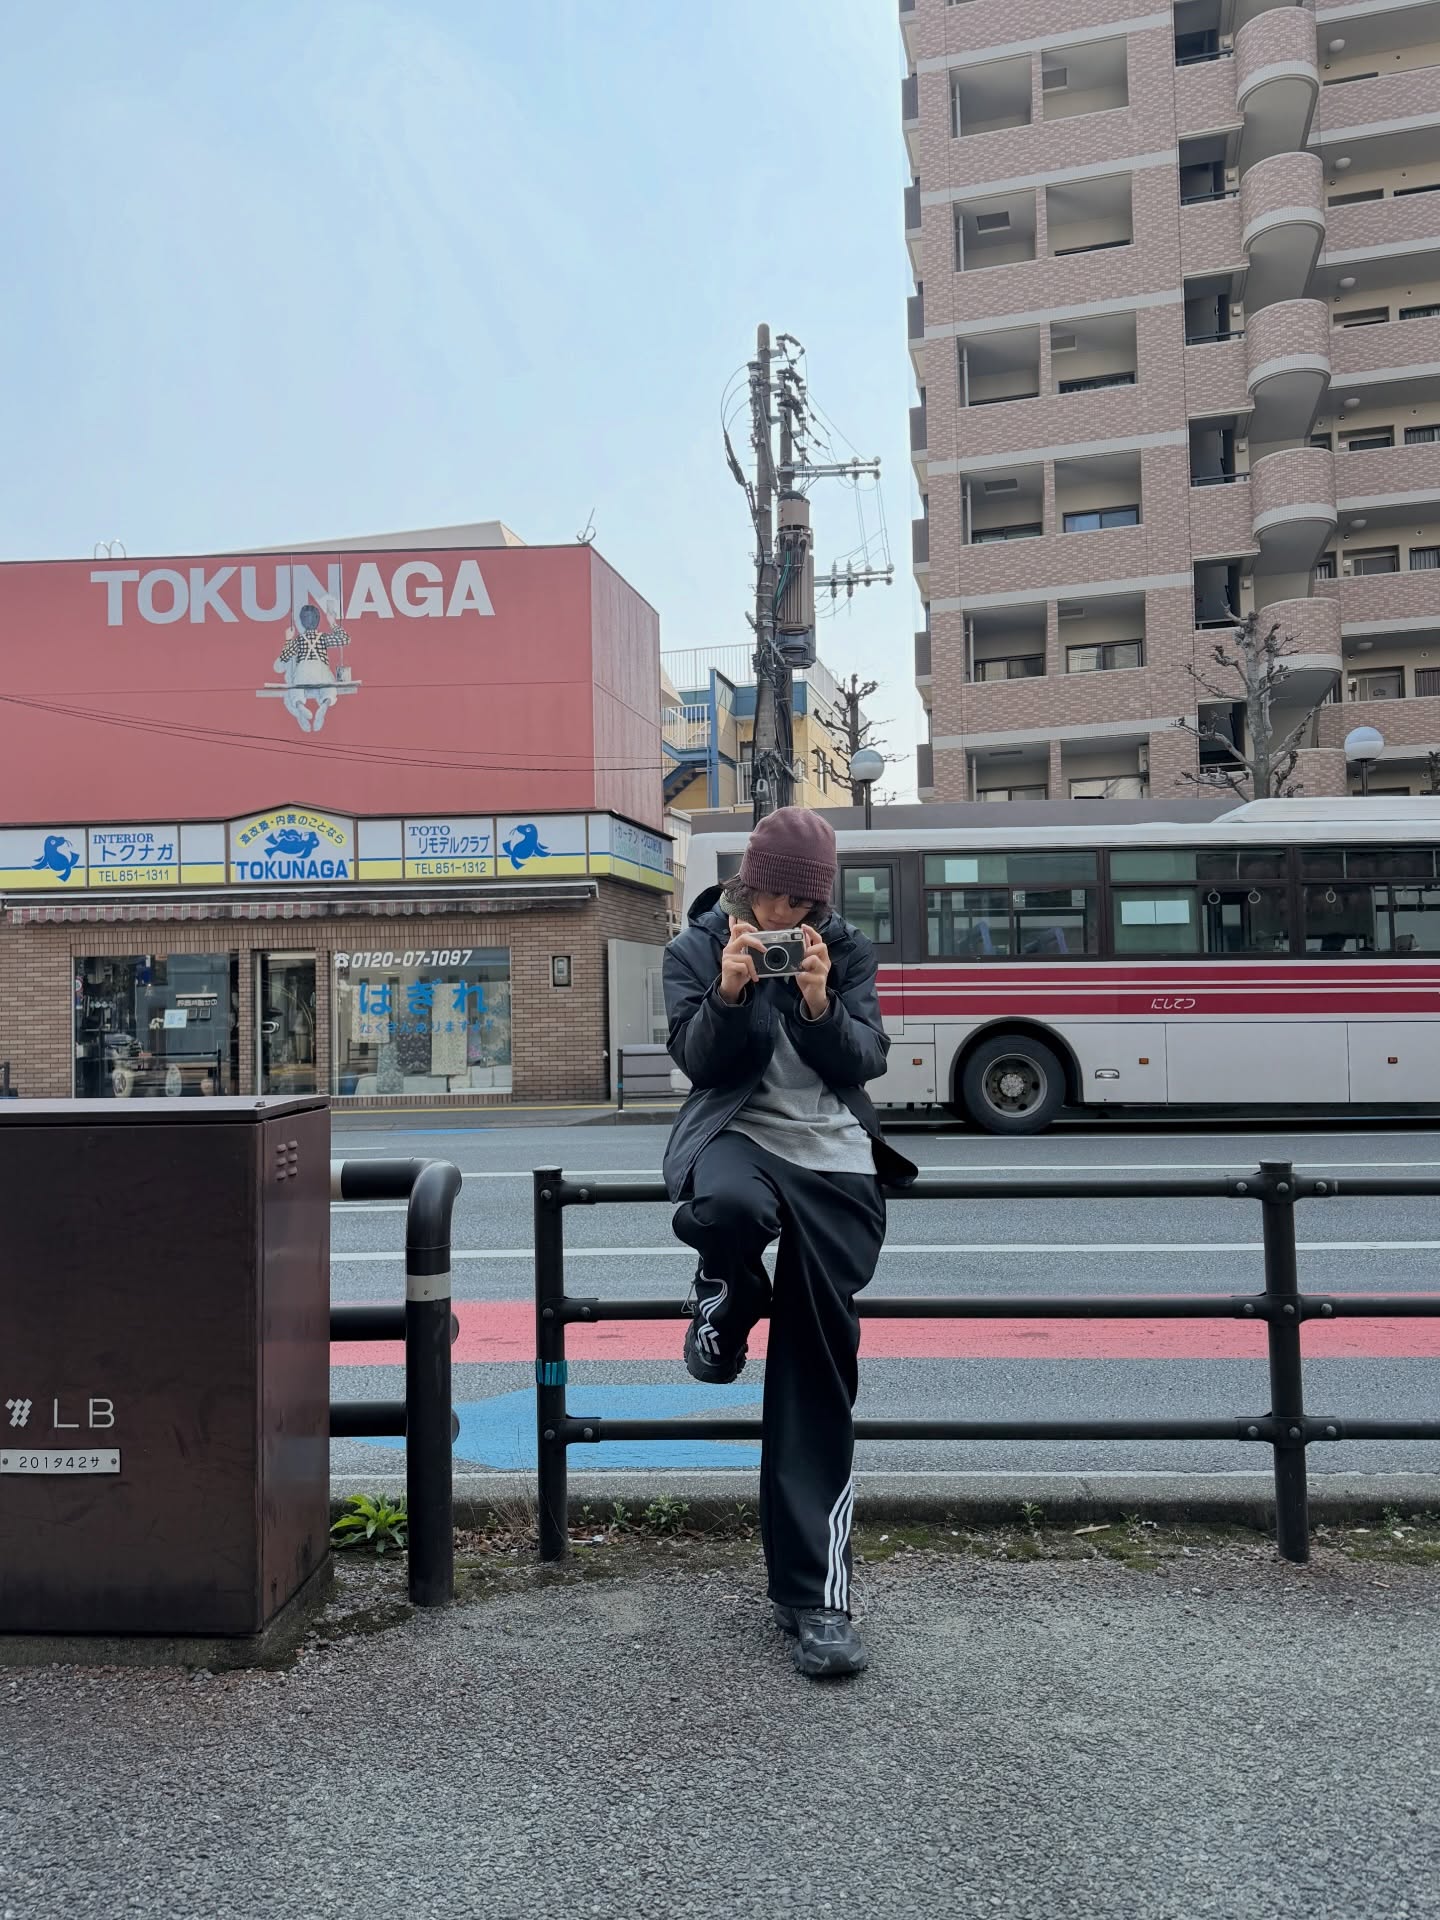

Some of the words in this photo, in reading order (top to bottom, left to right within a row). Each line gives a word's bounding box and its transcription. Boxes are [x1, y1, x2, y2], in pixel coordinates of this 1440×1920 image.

[90, 559, 496, 626] TOKUNAGA
[93, 832, 154, 845] INTERIOR
[408, 824, 451, 837] TOTO
[101, 843, 174, 862] トクナガ
[418, 834, 491, 855] リモデルクラブ
[236, 859, 349, 880] TOKUNAGA
[351, 949, 473, 969] 0120-07-1097
[358, 978, 488, 1016] はぎれ
[1151, 998, 1196, 1010] にしてつ
